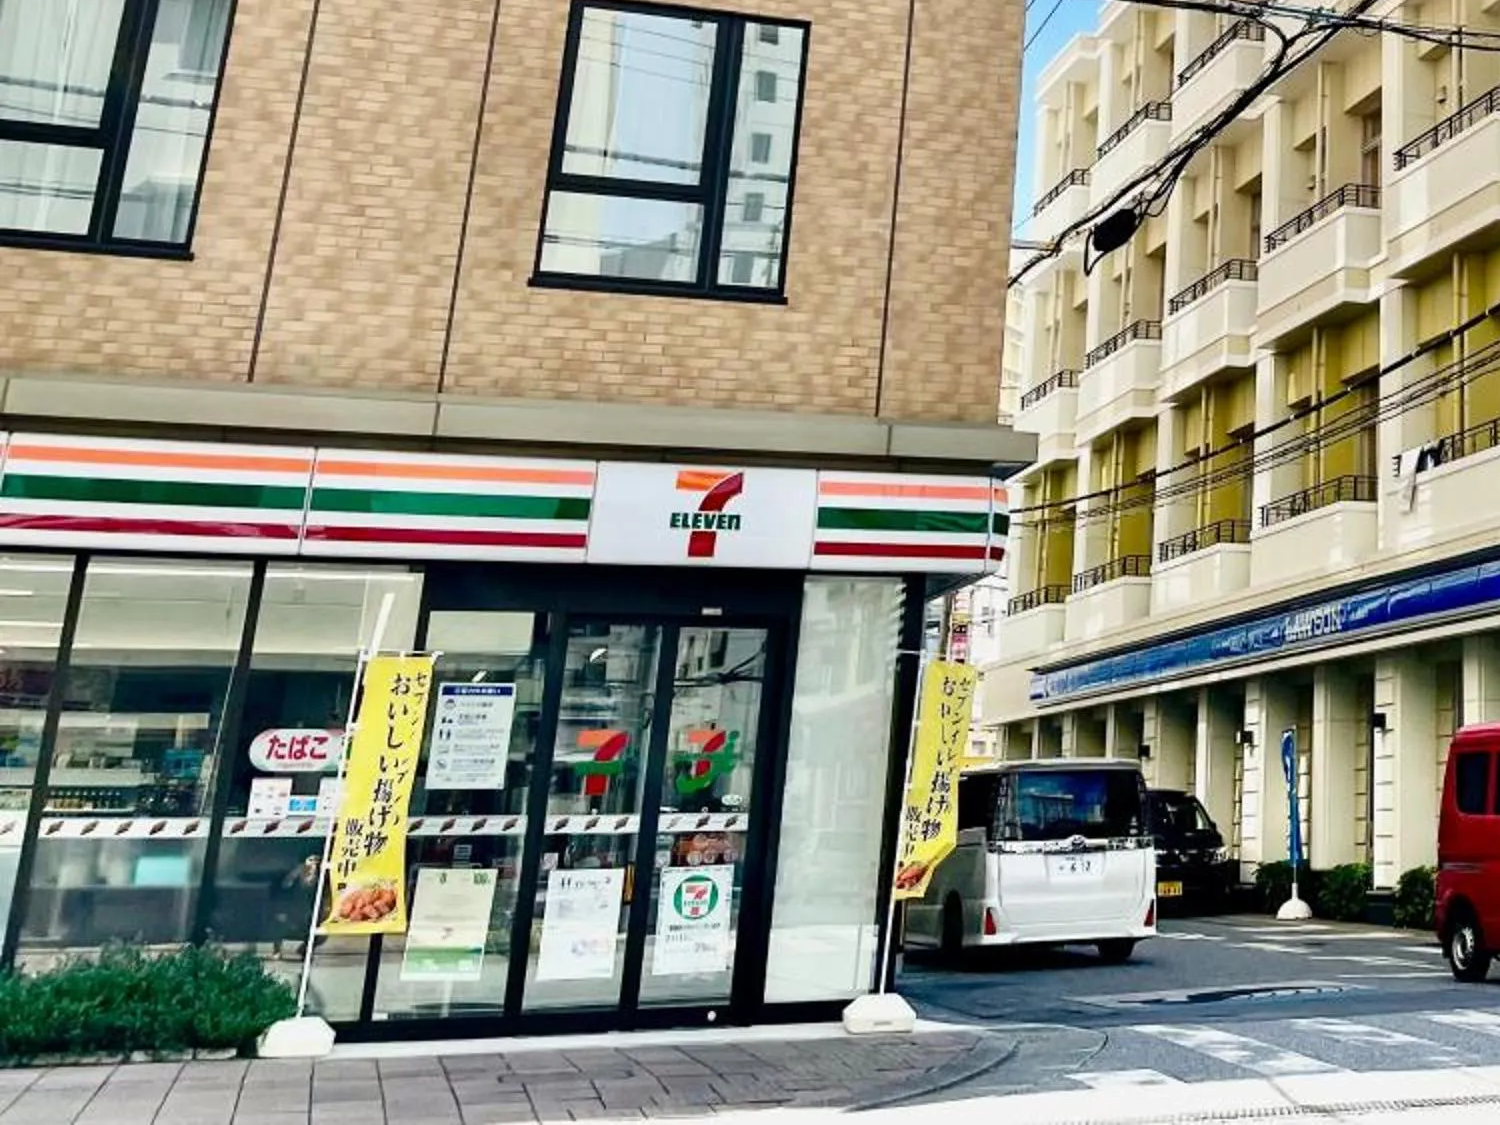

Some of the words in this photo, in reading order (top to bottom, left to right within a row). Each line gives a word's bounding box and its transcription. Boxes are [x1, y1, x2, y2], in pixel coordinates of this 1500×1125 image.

[1284, 603, 1343, 643] LAWSON
[264, 734, 329, 761] たばこ
